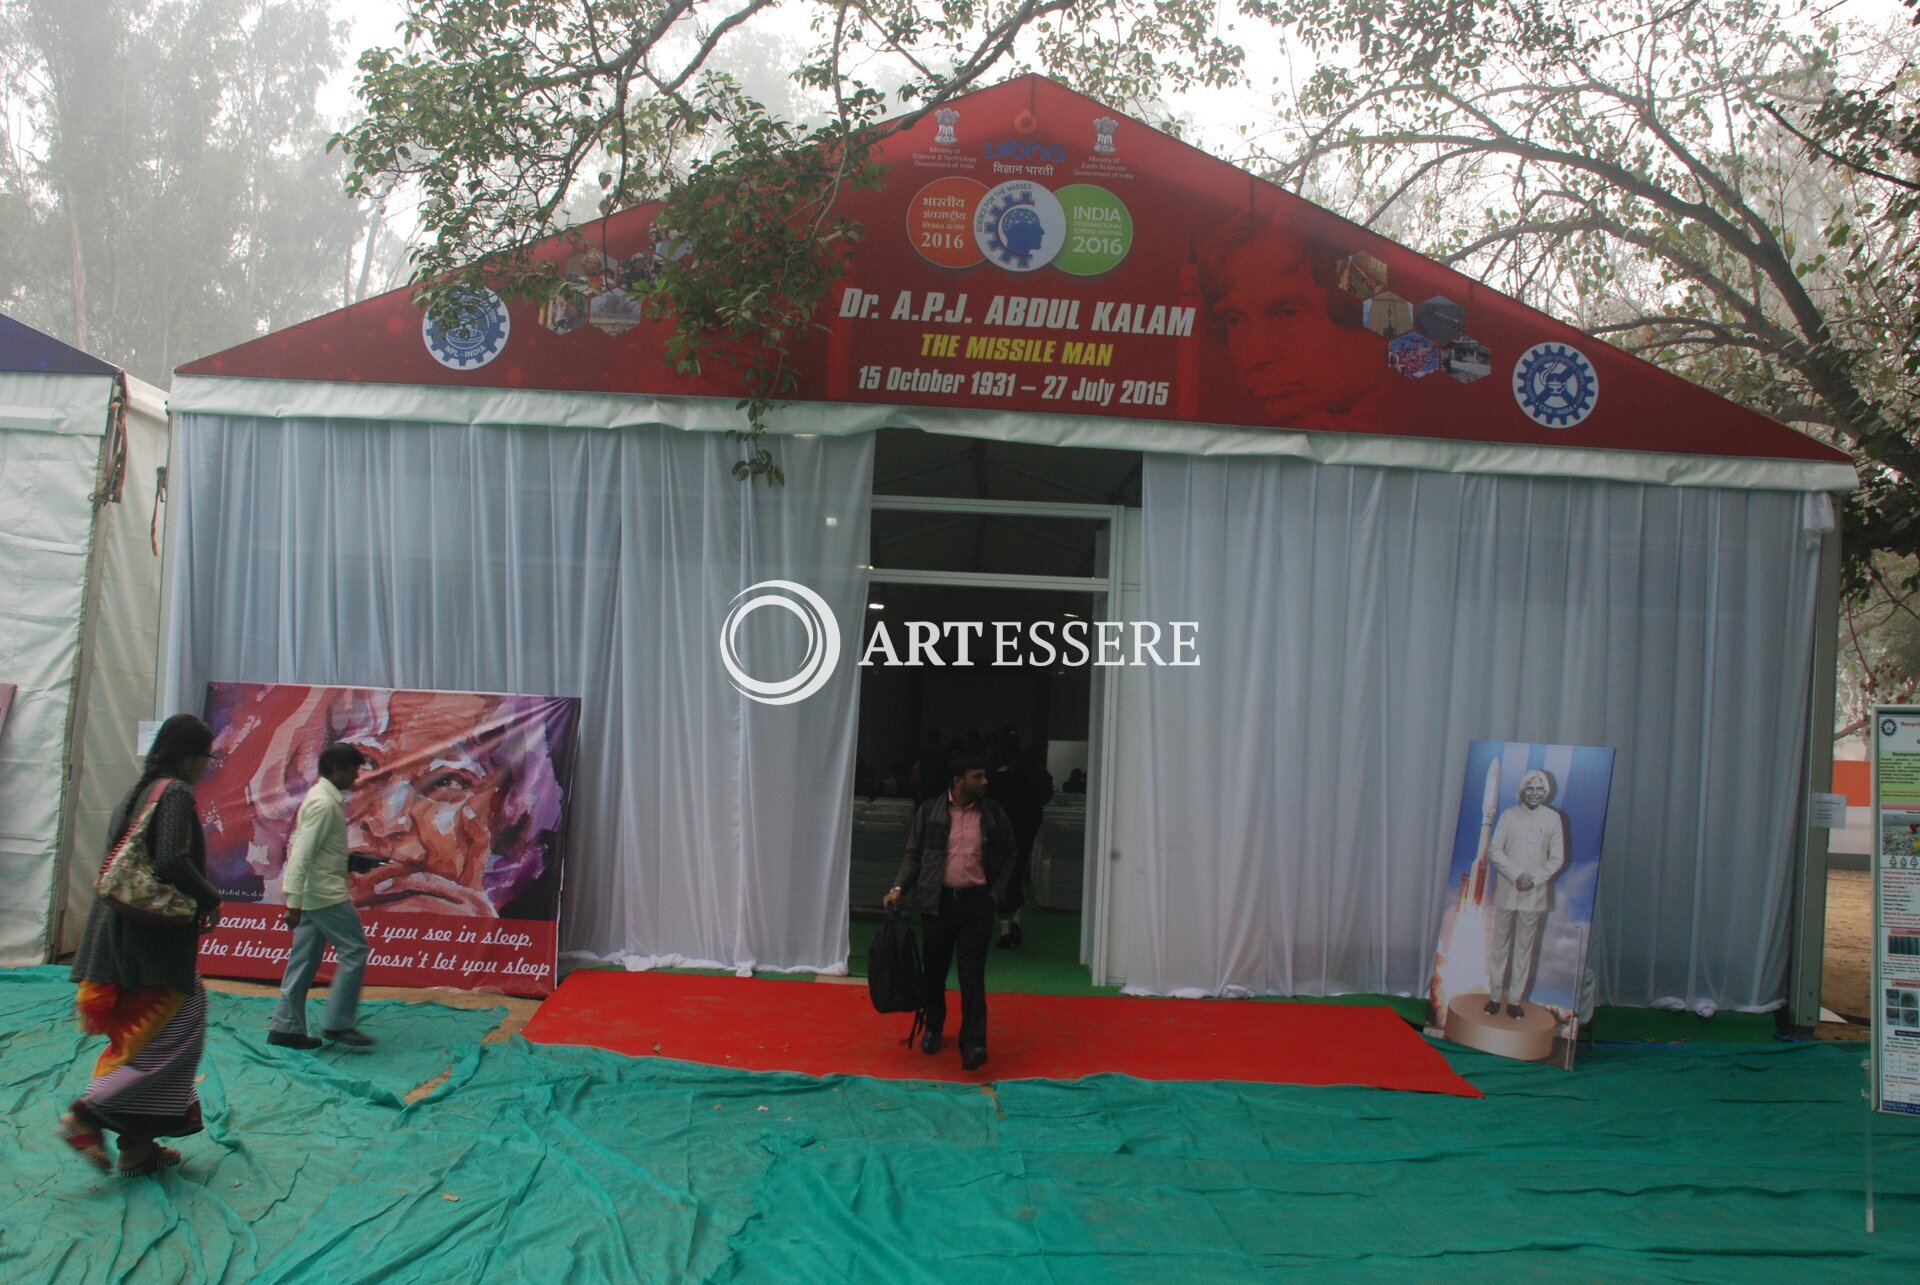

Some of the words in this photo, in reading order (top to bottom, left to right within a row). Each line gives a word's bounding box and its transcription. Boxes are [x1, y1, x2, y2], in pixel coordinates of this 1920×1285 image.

[912, 152, 936, 160] Science
[944, 154, 977, 163] Technology
[929, 146, 953, 155] Ministry
[913, 160, 951, 168] Government
[1088, 156, 1112, 165] Ministry
[993, 161, 1023, 174] विज्ञान
[1025, 164, 1053, 176] भारती
[1073, 169, 1110, 177] Government
[1099, 164, 1127, 172] Sciences
[1006, 183, 1032, 192] MASSES
[922, 195, 966, 208] भारतीय
[1073, 205, 1121, 222] INDIA
[921, 232, 964, 249] 2016
[1072, 236, 1123, 256] 2016
[838, 287, 880, 319] Dr.
[890, 290, 973, 324] A.P.J.
[983, 295, 1081, 330] ABDUL
[1091, 301, 1197, 337] KALAM
[444, 345, 459, 357] NPL
[464, 345, 487, 359] INDIA
[920, 333, 961, 358] THE
[965, 336, 1057, 364] MISSILE
[1061, 341, 1114, 367] MAN
[858, 365, 882, 390] 15
[886, 366, 966, 394] October
[970, 371, 1017, 397] 1931
[1041, 375, 1068, 400] 27
[1071, 377, 1115, 407] July
[1119, 380, 1170, 406] 2015
[1539, 405, 1553, 415] CSIR
[381, 926, 419, 943] you
[422, 929, 451, 942] see
[455, 925, 478, 944] in
[480, 928, 534, 951] sleep,
[199, 938, 227, 956] the
[231, 940, 291, 964] things
[431, 951, 458, 971] let
[460, 960, 498, 977] you
[501, 957, 551, 981] sleep
